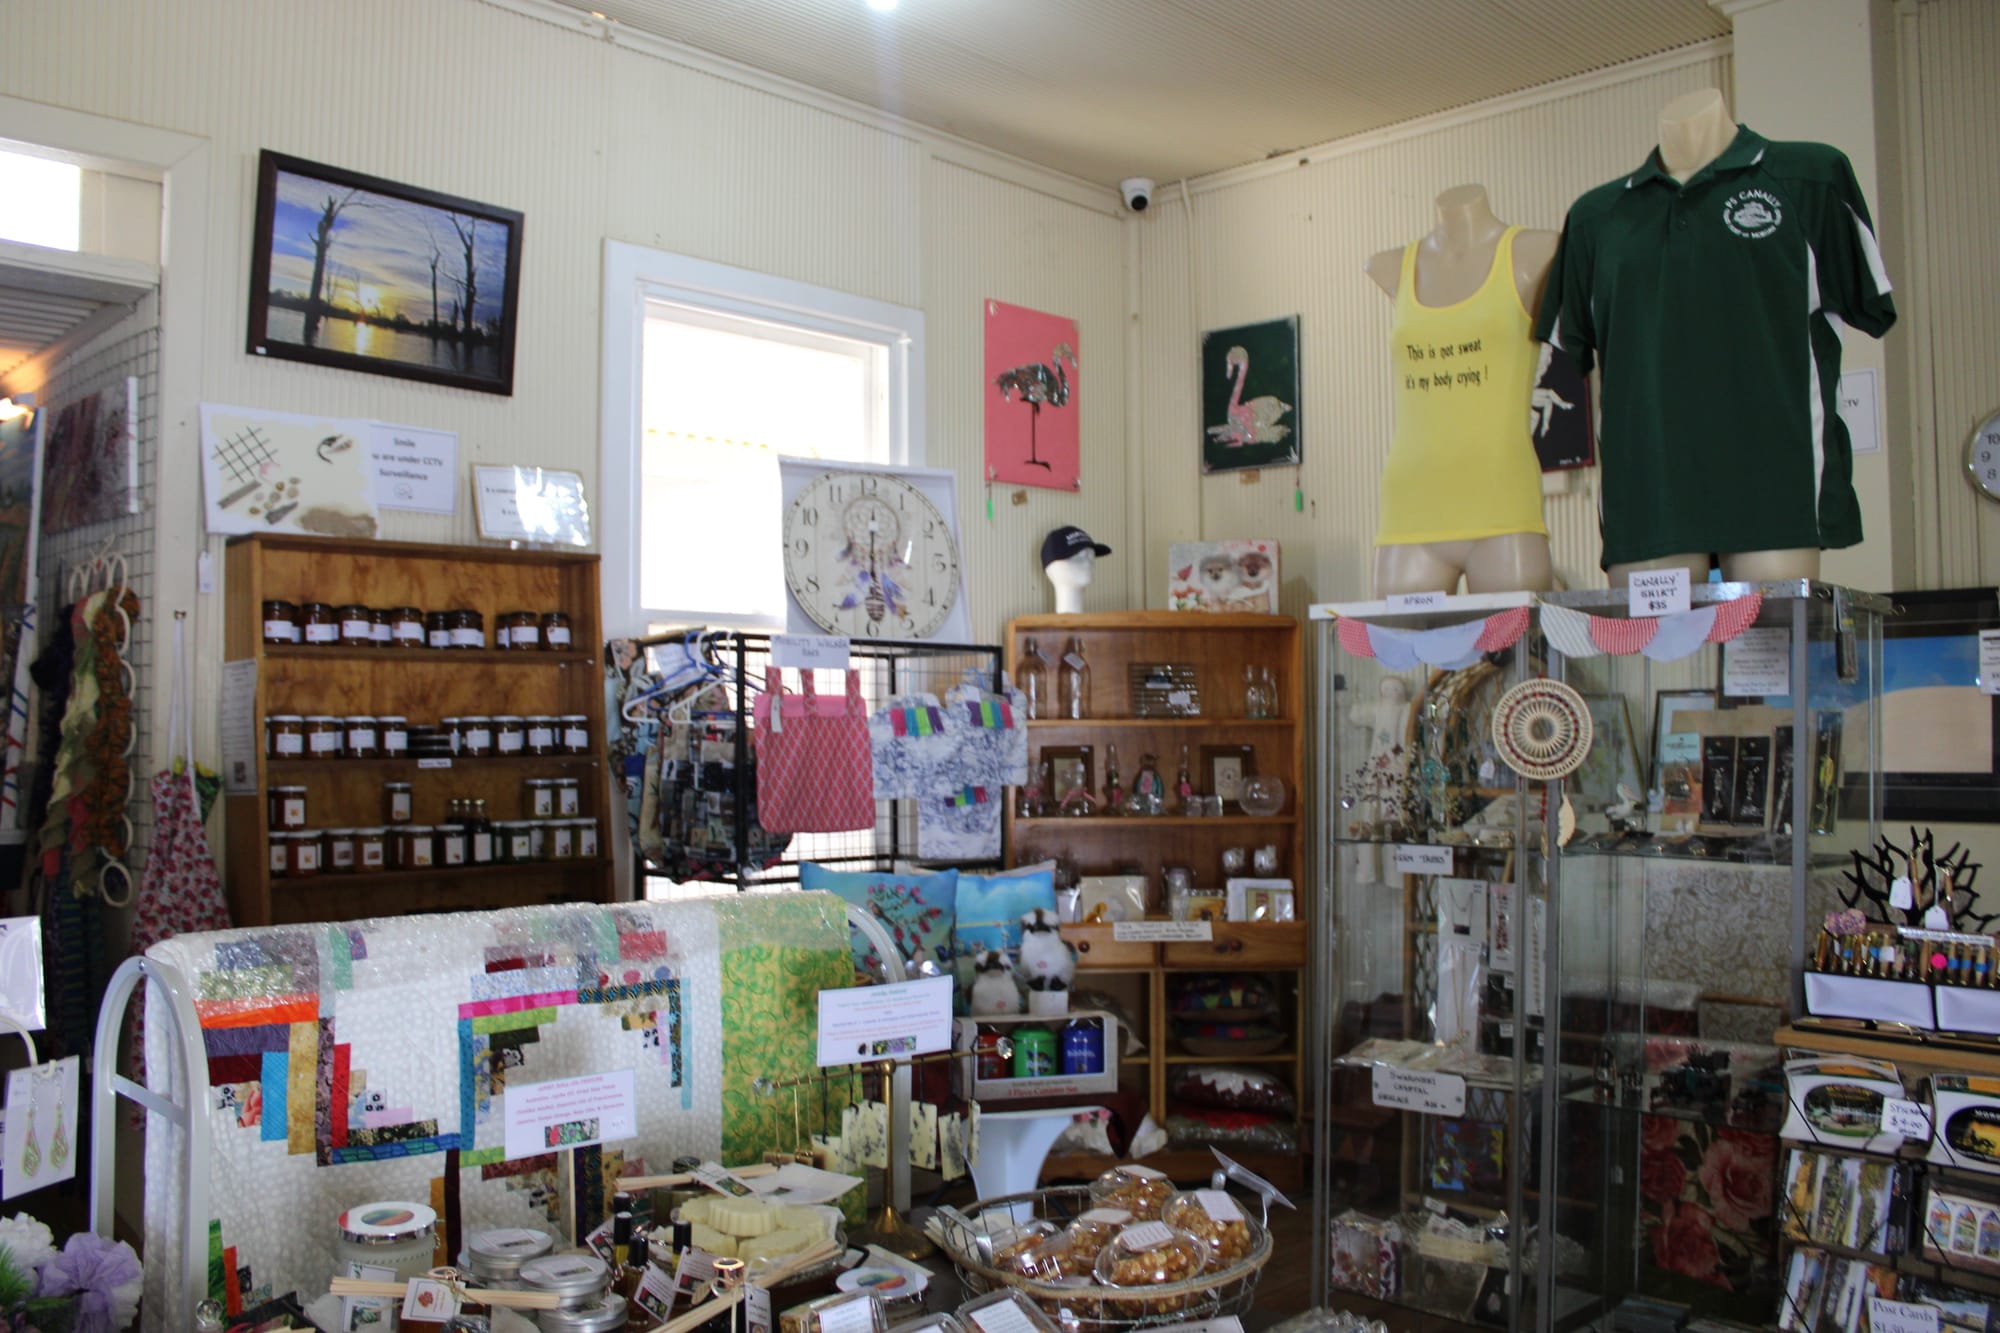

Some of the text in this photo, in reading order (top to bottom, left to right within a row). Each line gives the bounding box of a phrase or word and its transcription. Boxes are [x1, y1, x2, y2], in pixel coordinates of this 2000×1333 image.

[1738, 188, 1781, 209] CANALLY
[1406, 337, 1482, 362] This is not sweat
[1405, 373, 1416, 390] it's
[1418, 376, 1430, 393] my
[1433, 370, 1453, 392] body
[1456, 366, 1481, 388] crying
[393, 437, 416, 448] Smile
[397, 456, 421, 465] under
[422, 456, 443, 467] CCTV
[1981, 450, 1991, 463] 9
[379, 468, 428, 481] Surveillance
[1987, 468, 1997, 481] 8
[829, 484, 843, 503] 11
[860, 477, 878, 498] 12
[802, 507, 819, 527] 10
[922, 520, 935, 540] 2
[796, 538, 809, 558] 9
[805, 575, 820, 594] 8
[1633, 574, 1677, 588] CANALLY
[923, 587, 935, 607] 4
[1403, 595, 1434, 606] APRON
[1640, 586, 1678, 599] SHIRT
[1648, 600, 1668, 612] $35
[866, 620, 880, 638] 6
[1872, 1298, 1934, 1321] Post Cards
